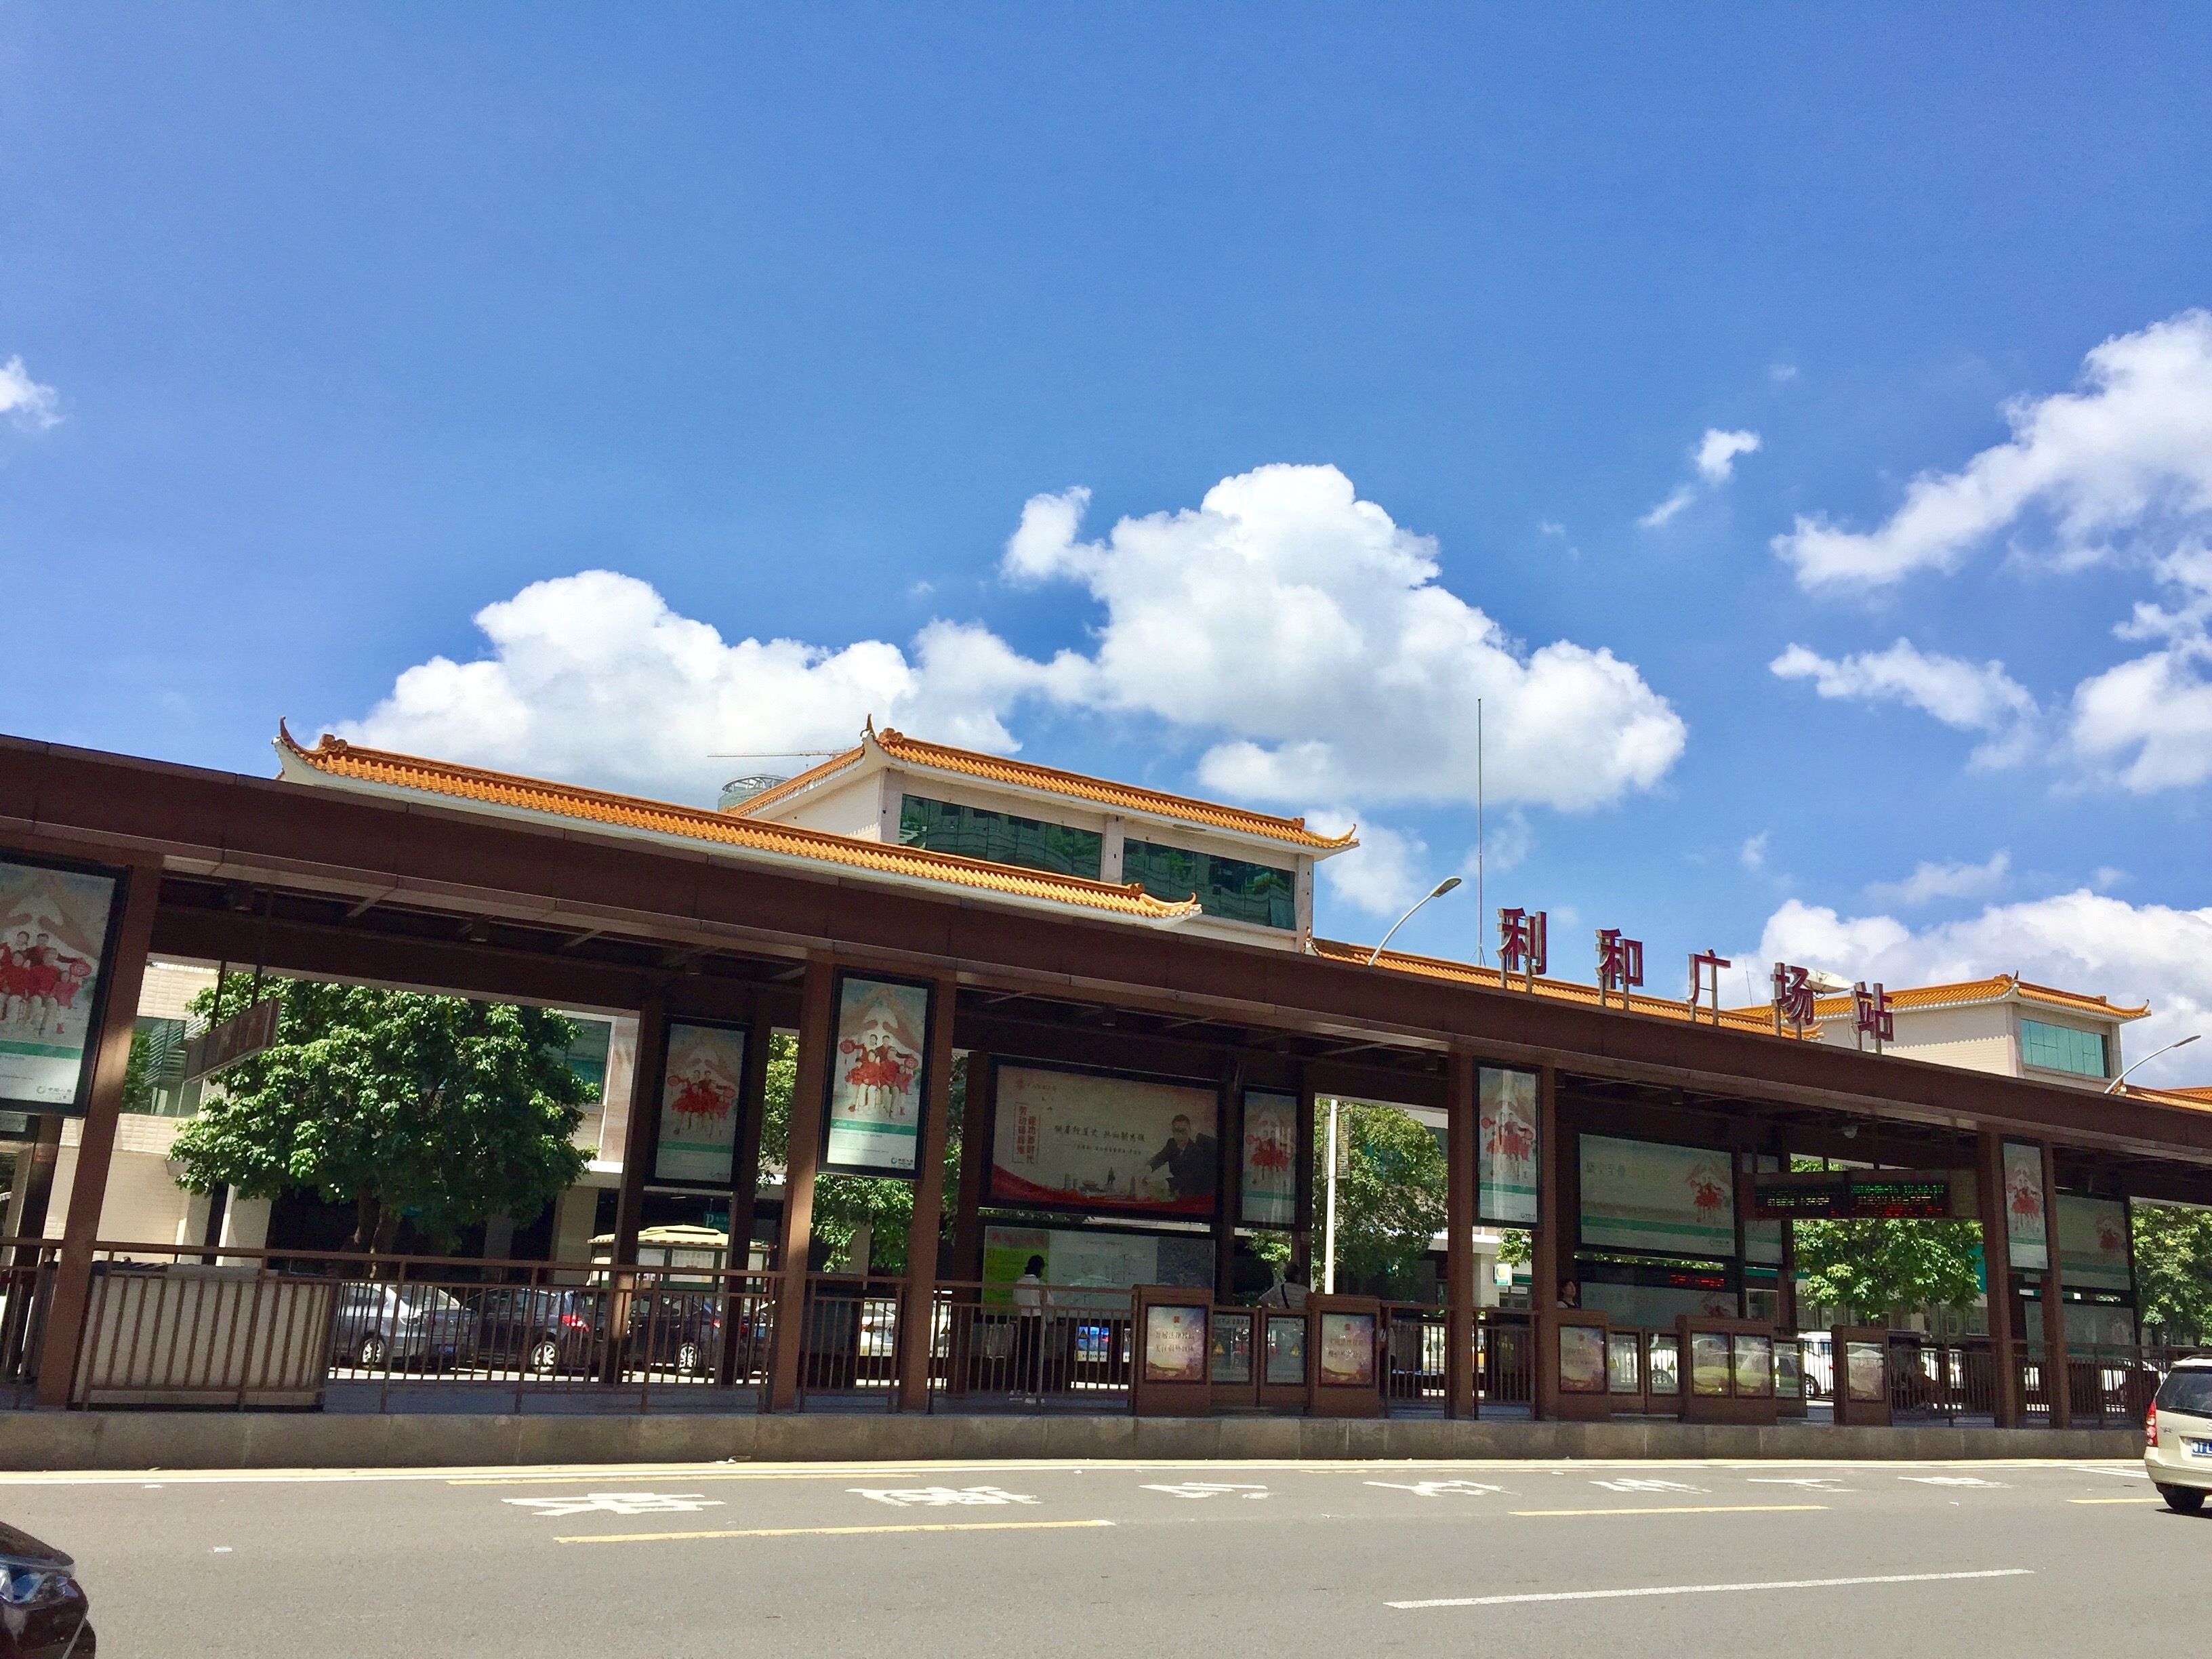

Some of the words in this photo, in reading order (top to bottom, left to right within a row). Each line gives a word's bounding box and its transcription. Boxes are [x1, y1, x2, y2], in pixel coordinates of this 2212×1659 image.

[1497, 907, 1894, 1042] 利和广场站
